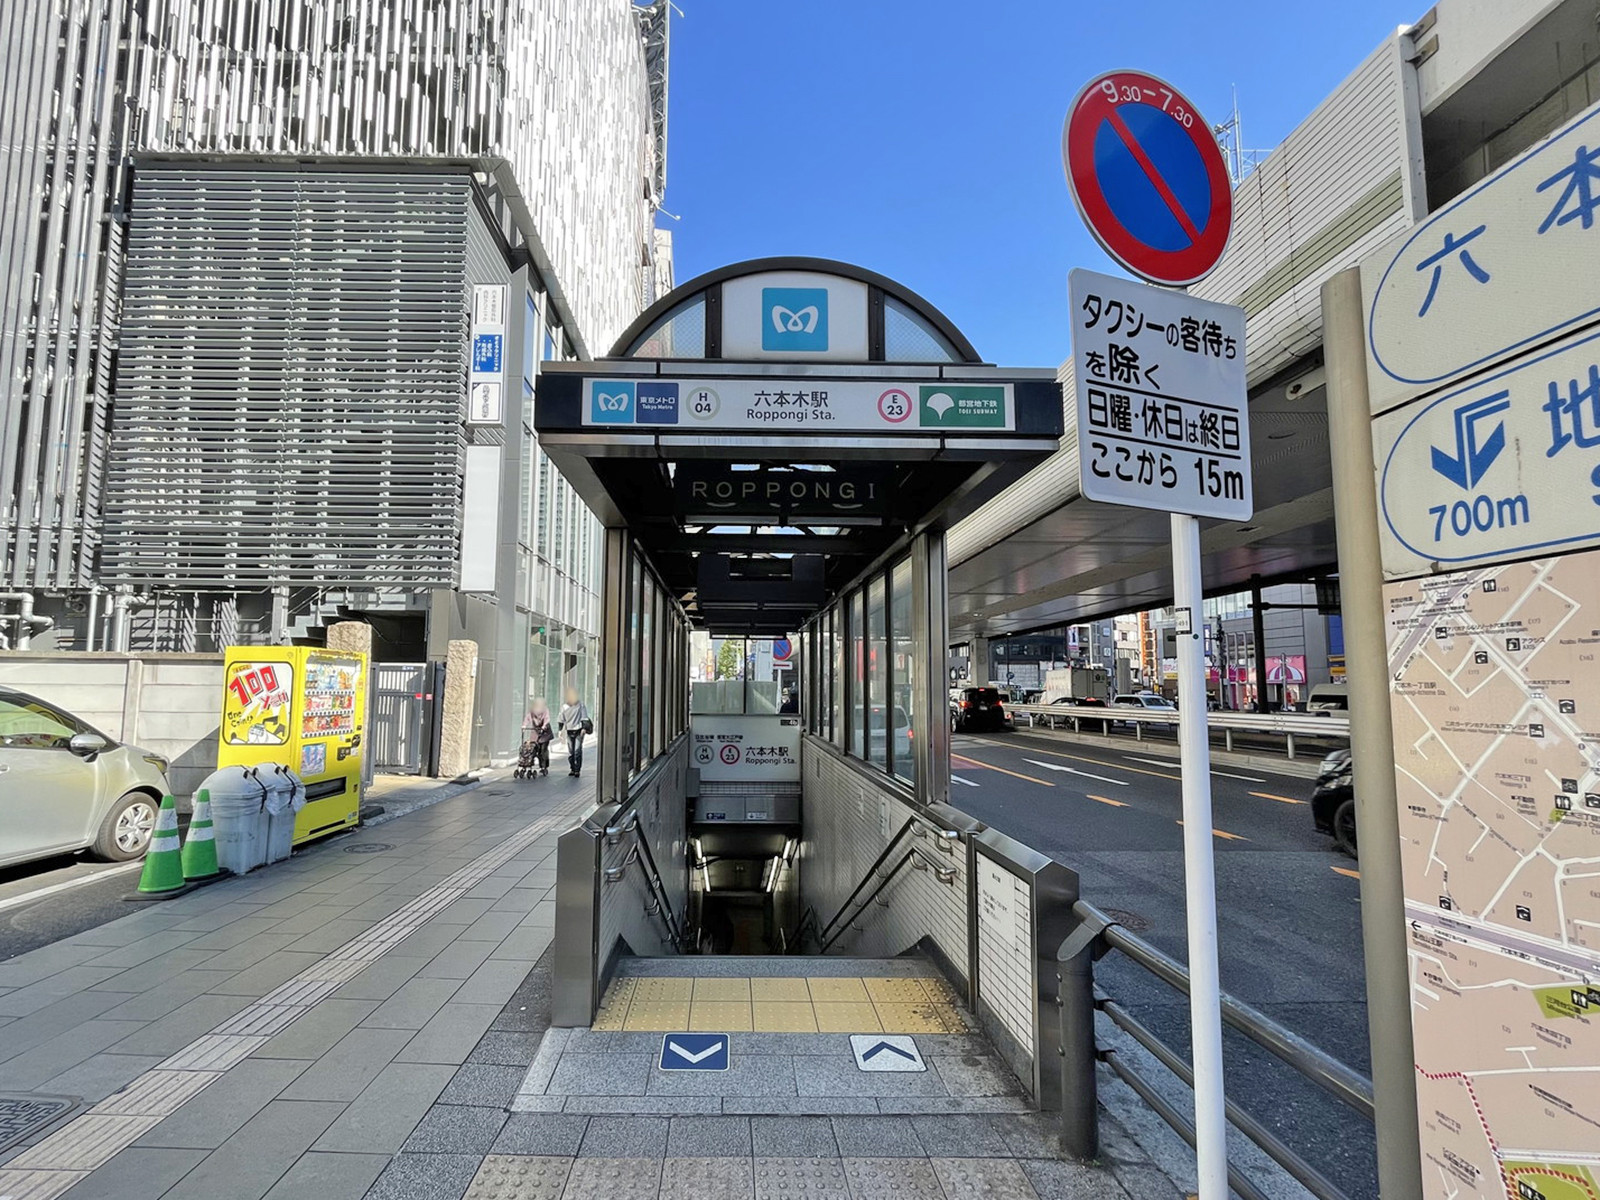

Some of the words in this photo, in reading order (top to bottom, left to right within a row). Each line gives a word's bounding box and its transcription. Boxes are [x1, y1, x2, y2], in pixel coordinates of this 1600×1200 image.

[1083, 294, 1237, 360] タクシーの客待ち
[1086, 343, 1160, 390] を除く
[640, 396, 676, 404] 東京メトロ
[699, 392, 708, 402] H
[754, 390, 829, 408] 六本木駅
[892, 394, 898, 404] E
[695, 402, 711, 413] 04
[747, 408, 808, 422] Roppongi
[812, 409, 835, 420] Sta.
[887, 405, 903, 415] 23
[1088, 388, 1240, 450] 日曜・休日は終日
[1092, 441, 1178, 489] ここから
[1194, 457, 1244, 500] 15m
[692, 481, 875, 499] ROPPONGI
[1429, 494, 1530, 542] 700m
[229, 666, 279, 707] 100
[745, 746, 789, 757] 六本木駅
[745, 757, 781, 766] Roppongi
